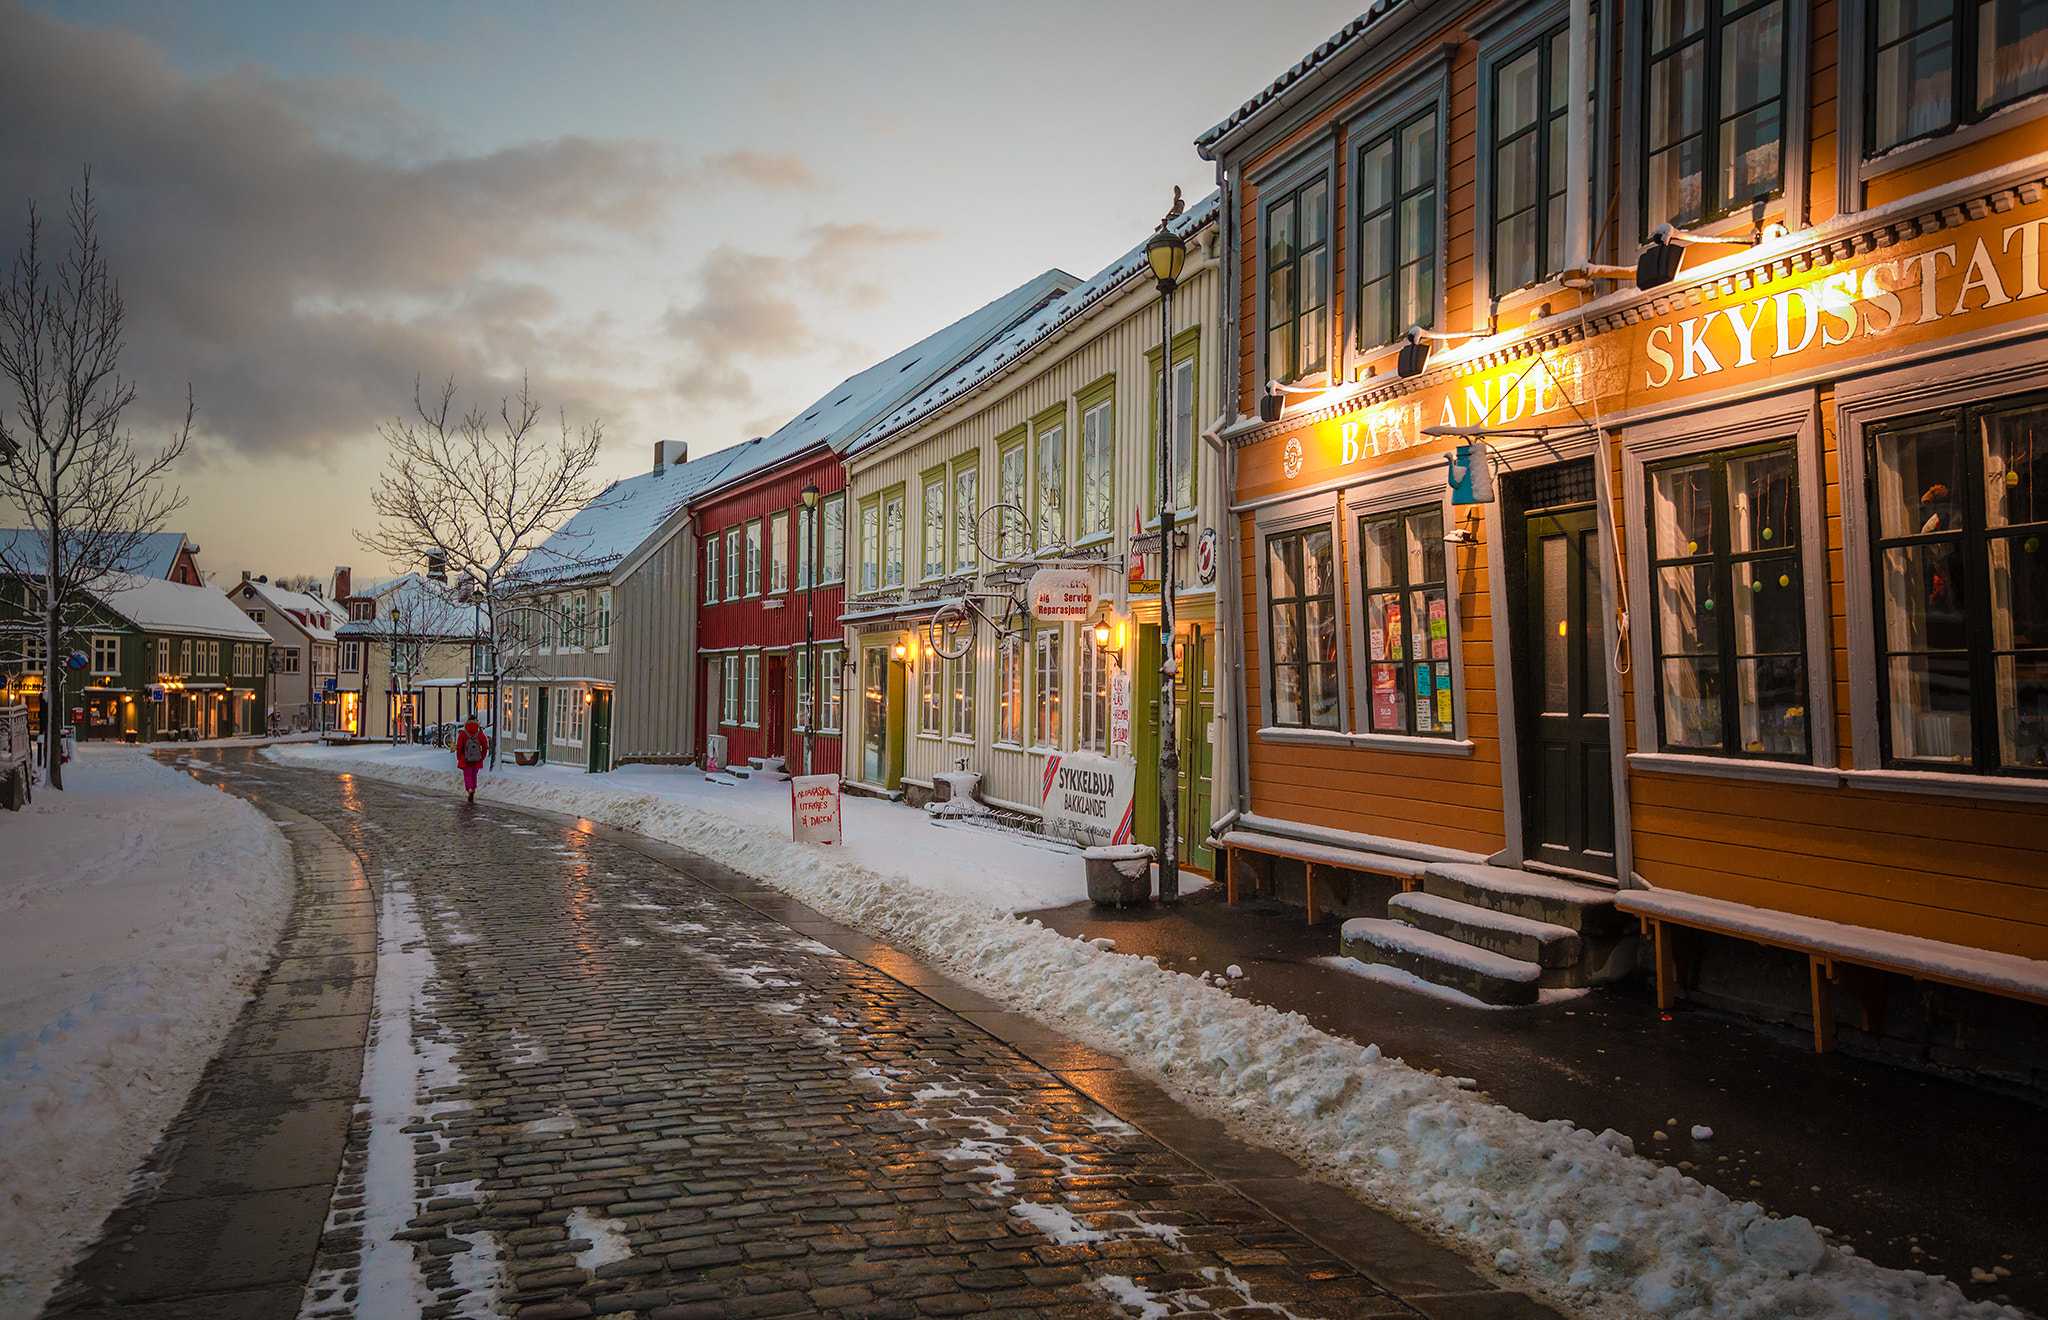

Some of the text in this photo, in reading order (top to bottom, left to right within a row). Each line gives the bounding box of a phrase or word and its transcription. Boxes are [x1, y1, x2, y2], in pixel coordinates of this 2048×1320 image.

[1064, 592, 1092, 603] Service
[1038, 605, 1088, 616] Reparasjoner
[1058, 766, 1115, 798] SYKKELBUA
[1064, 793, 1107, 819] BAKKLANDET
